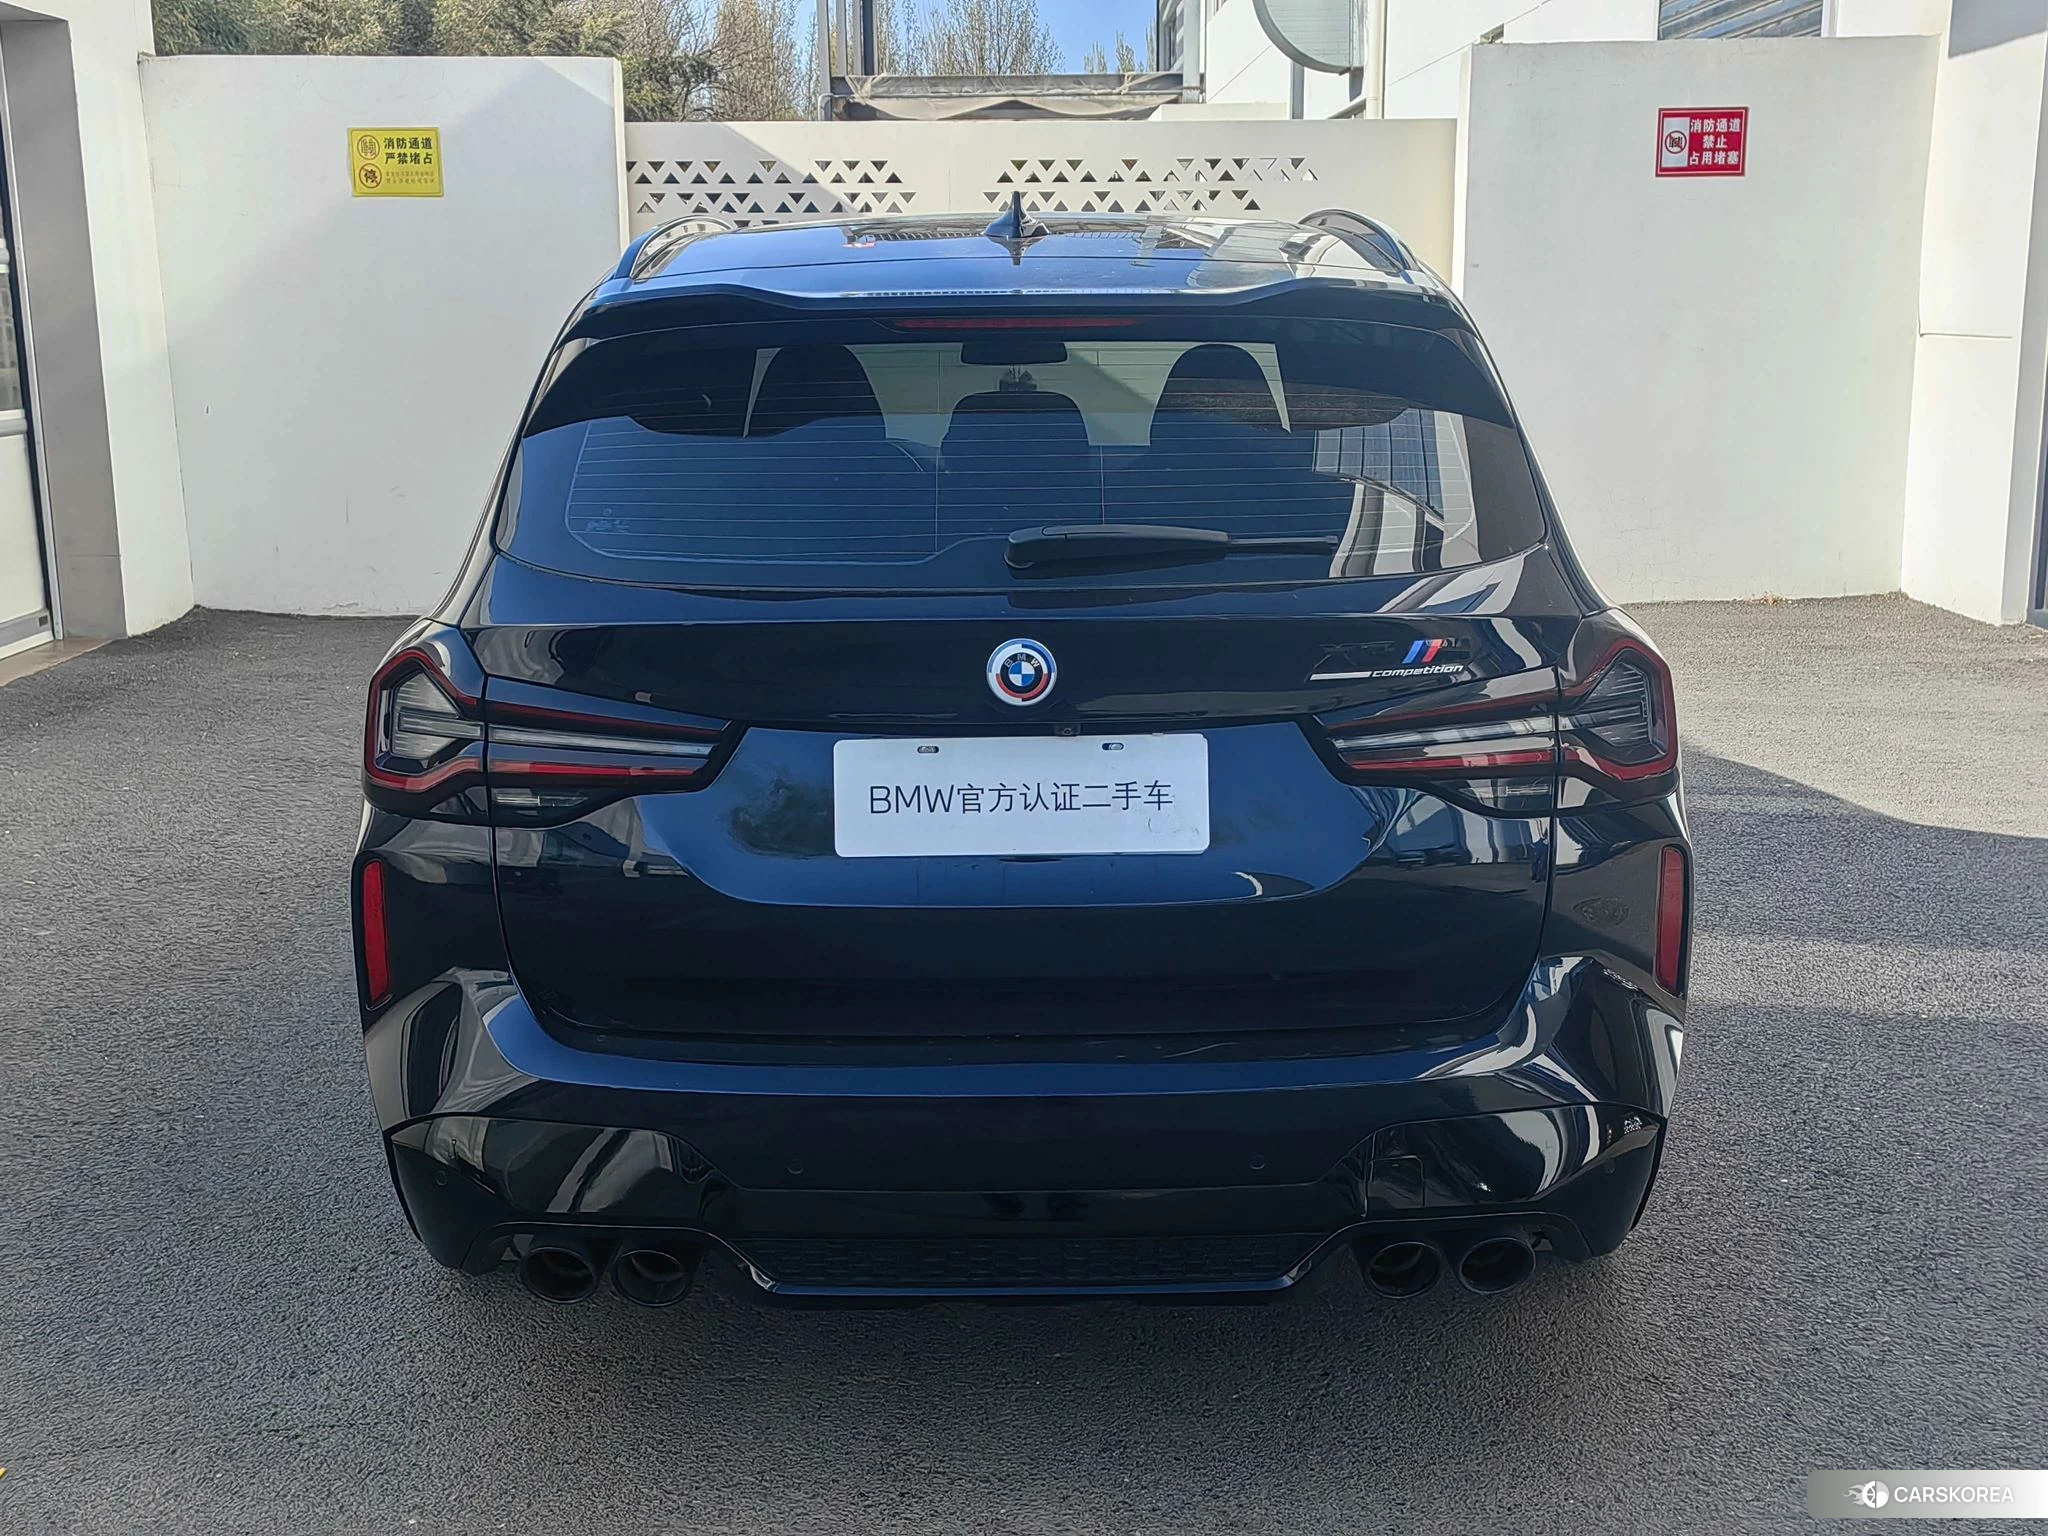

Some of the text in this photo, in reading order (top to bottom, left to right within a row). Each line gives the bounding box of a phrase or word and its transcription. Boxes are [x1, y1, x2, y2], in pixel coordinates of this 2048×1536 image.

[1690, 118, 1741, 133] 消防通道
[383, 137, 433, 150] 消防通道
[1702, 134, 1728, 149] 禁止
[384, 152, 433, 165] 严禁堵占
[1689, 150, 1739, 166] 占用堵塞
[1003, 653, 1041, 668] BMW
[1371, 664, 1464, 678] competition
[869, 780, 1174, 815] BMW官方认证二手车
